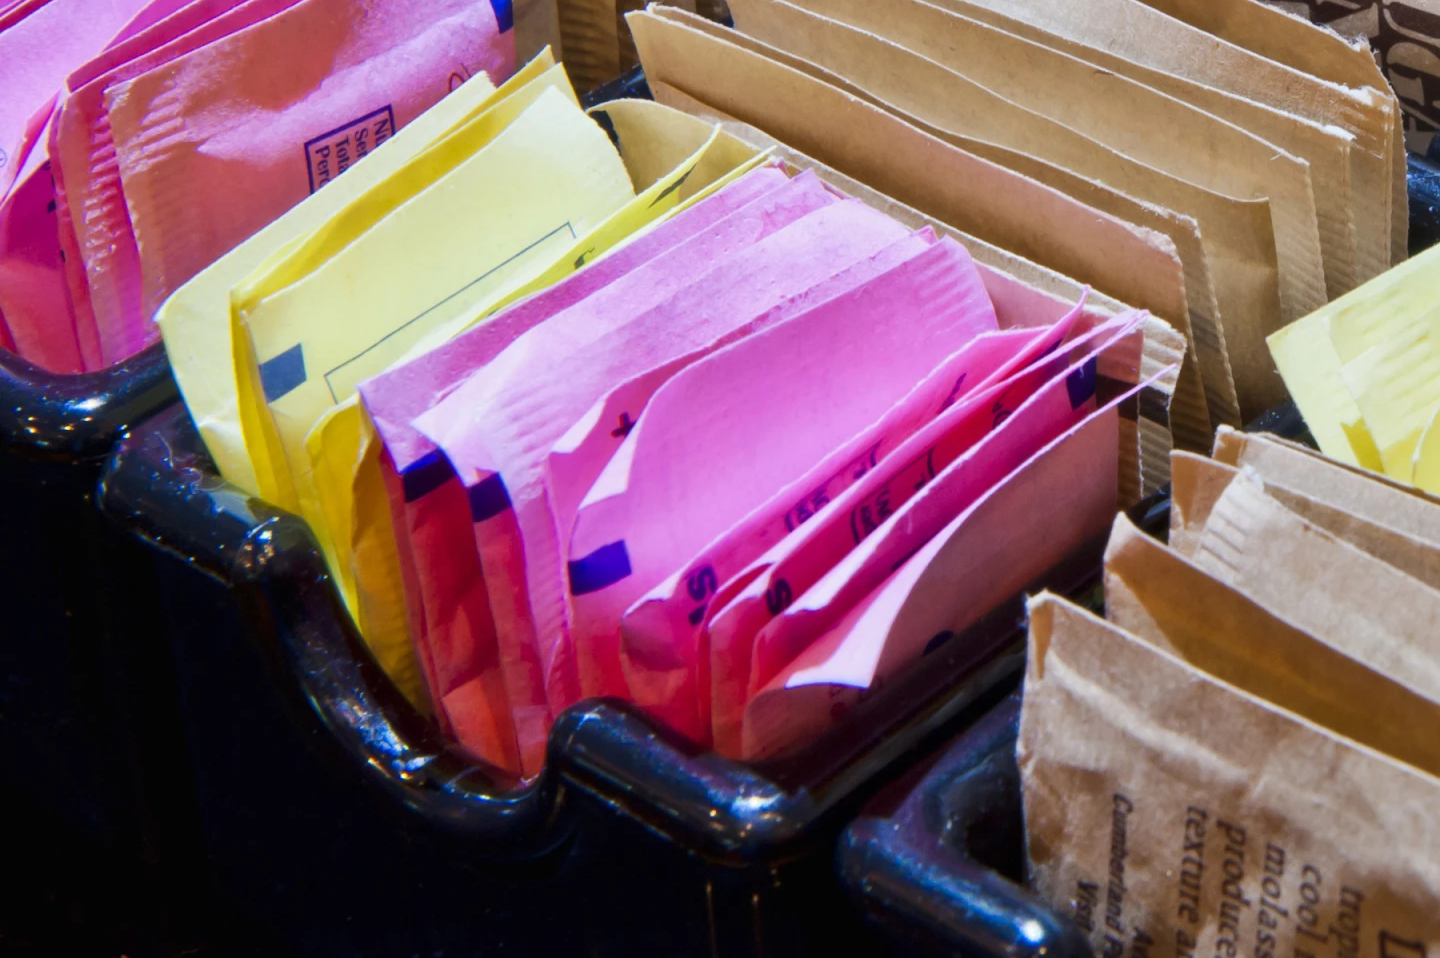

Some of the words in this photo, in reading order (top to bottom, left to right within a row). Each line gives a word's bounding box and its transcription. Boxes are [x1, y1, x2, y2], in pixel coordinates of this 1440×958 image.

[315, 145, 331, 188] Perc
[335, 134, 350, 174] Tota
[1177, 805, 1208, 924] texture
[1215, 817, 1251, 958] produce
[1254, 842, 1289, 958] molass
[1296, 863, 1330, 945] cool
